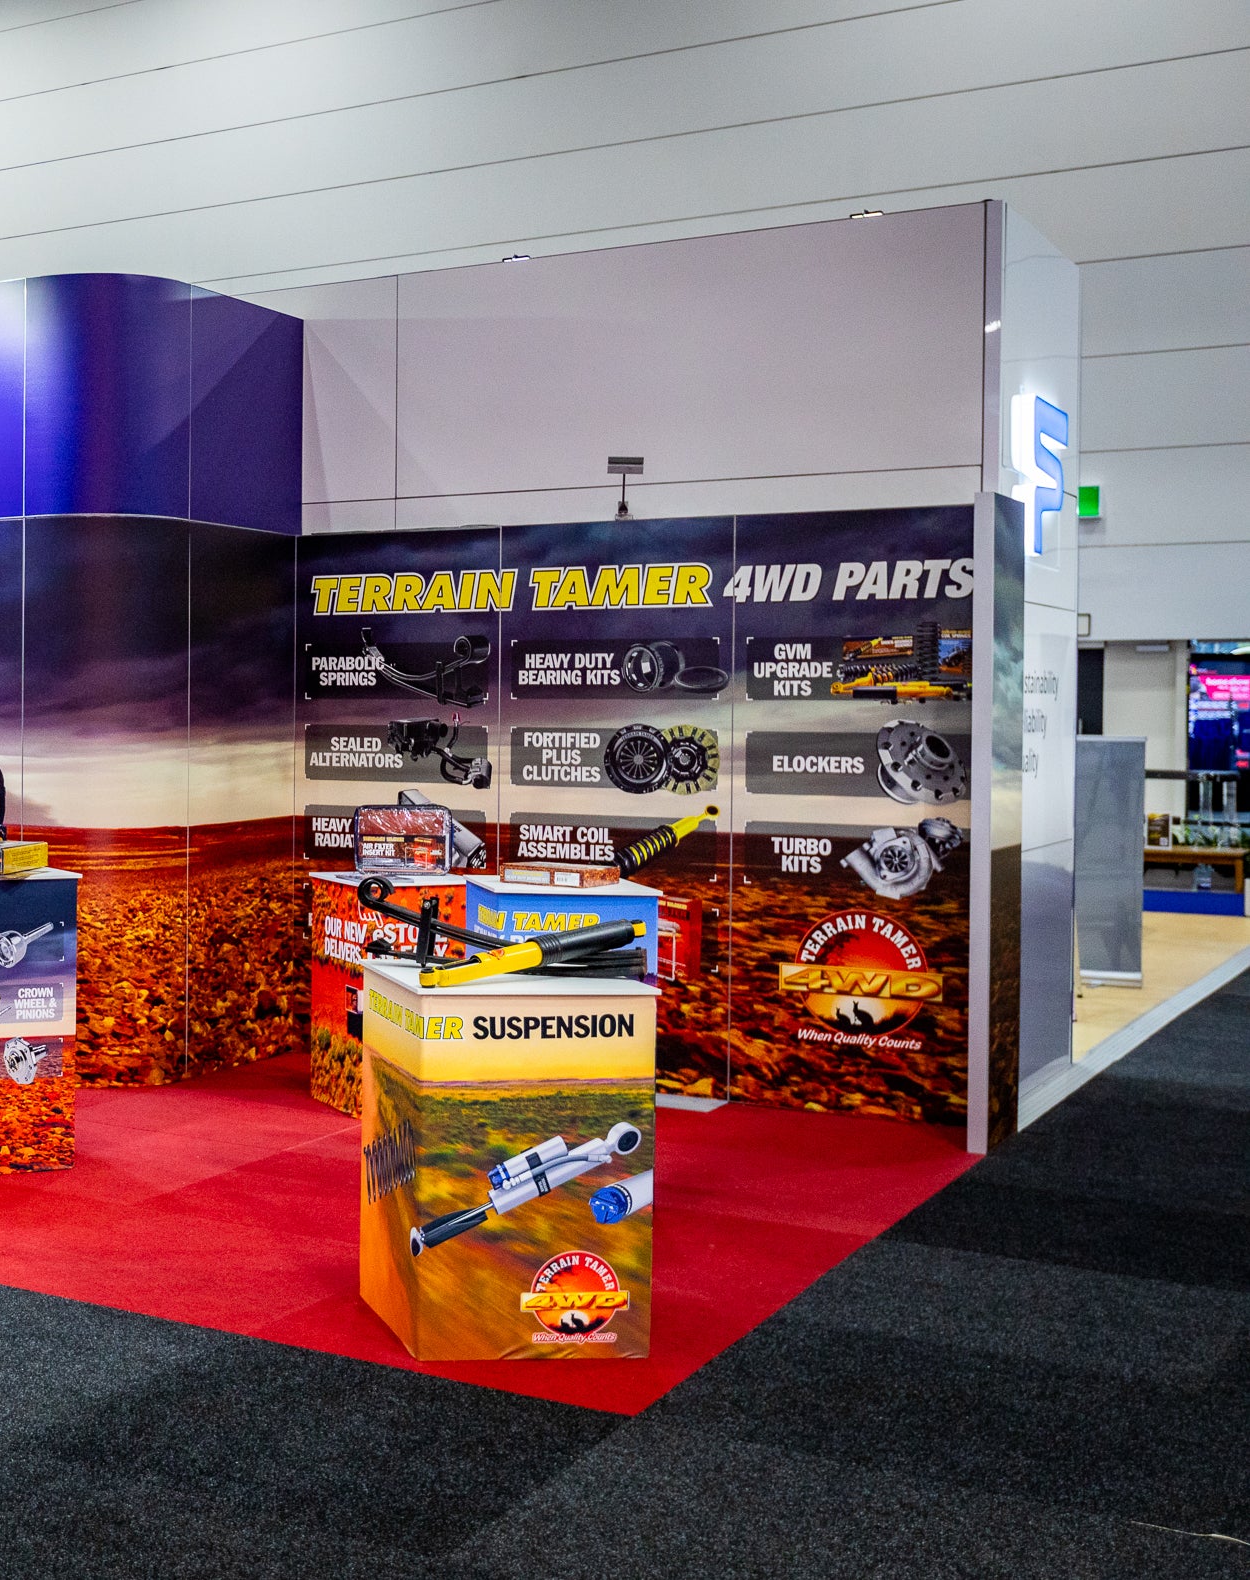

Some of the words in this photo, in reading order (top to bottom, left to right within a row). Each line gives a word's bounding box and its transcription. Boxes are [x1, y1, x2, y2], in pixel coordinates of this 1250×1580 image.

[311, 569, 518, 615] TERRAIN
[529, 562, 714, 612] TAMER
[723, 562, 823, 603] 4WD
[832, 558, 974, 601] PARTS
[525, 653, 571, 669] HEAVY
[574, 652, 615, 669] DUTY
[773, 643, 811, 660] GVM
[311, 655, 385, 672] PARABOLIC
[753, 661, 833, 679] UPGRADE
[319, 671, 377, 687] SPRINGS
[518, 669, 583, 686] BEARING
[586, 668, 621, 685] KITS
[773, 679, 812, 697] KITS
[330, 736, 381, 752] SEALED
[523, 731, 601, 749] FORTIFIED
[309, 751, 403, 769] ALTERNATORS
[541, 749, 581, 765] PLUS
[772, 755, 865, 774] ELOCKERS
[522, 764, 601, 783] CLUTCHES
[312, 817, 352, 833] HEAVY
[519, 824, 573, 843] SMART
[576, 825, 614, 844] COIL
[374, 842, 394, 850] FILTER
[517, 841, 615, 862] ASSEMBLIES
[771, 836, 832, 856] TURBO
[781, 855, 822, 873] KITS
[325, 915, 342, 938] OUR
[344, 920, 368, 944] NEW
[324, 936, 362, 964] DELIVERS
[800, 914, 867, 963] TERRAIN
[872, 916, 922, 970] TAMER
[783, 967, 942, 999] 4WD
[18, 987, 54, 999] CROWN
[14, 998, 49, 1010] WHEEL
[49, 997, 57, 1009] &
[15, 1009, 56, 1021] PINIONS
[369, 988, 403, 1027] TERRAIN
[404, 1007, 465, 1041] TAMER
[472, 1013, 635, 1041] SUSPENSION
[797, 1028, 832, 1043] When
[833, 1031, 877, 1049] Quality
[878, 1036, 922, 1050] Counts
[535, 1255, 580, 1293] TERRAIN
[584, 1256, 615, 1291] TAMER
[524, 1294, 628, 1310] 4WD
